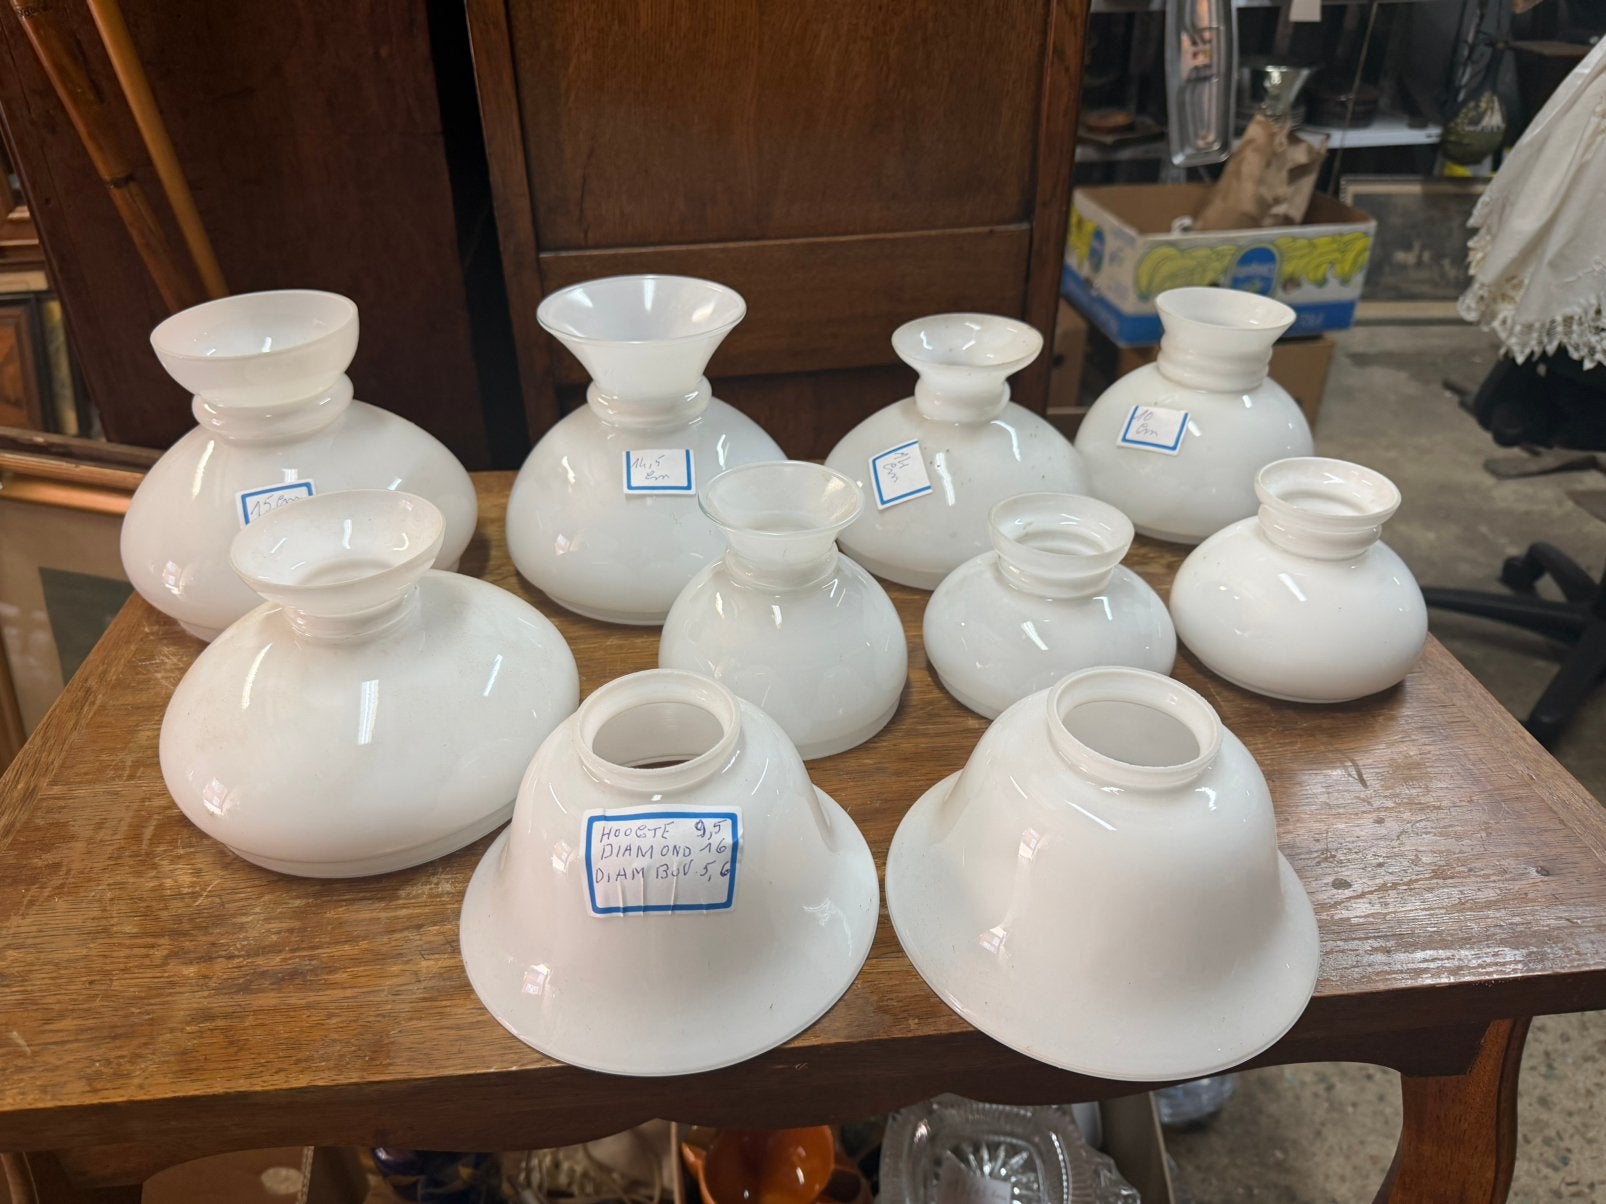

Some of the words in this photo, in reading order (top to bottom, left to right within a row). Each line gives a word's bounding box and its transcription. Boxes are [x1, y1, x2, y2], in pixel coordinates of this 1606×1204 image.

[600, 821, 675, 843] HOOGTE
[694, 819, 727, 840] 9,5
[600, 843, 692, 860] DIAMOND
[595, 867, 645, 884] DIAM
